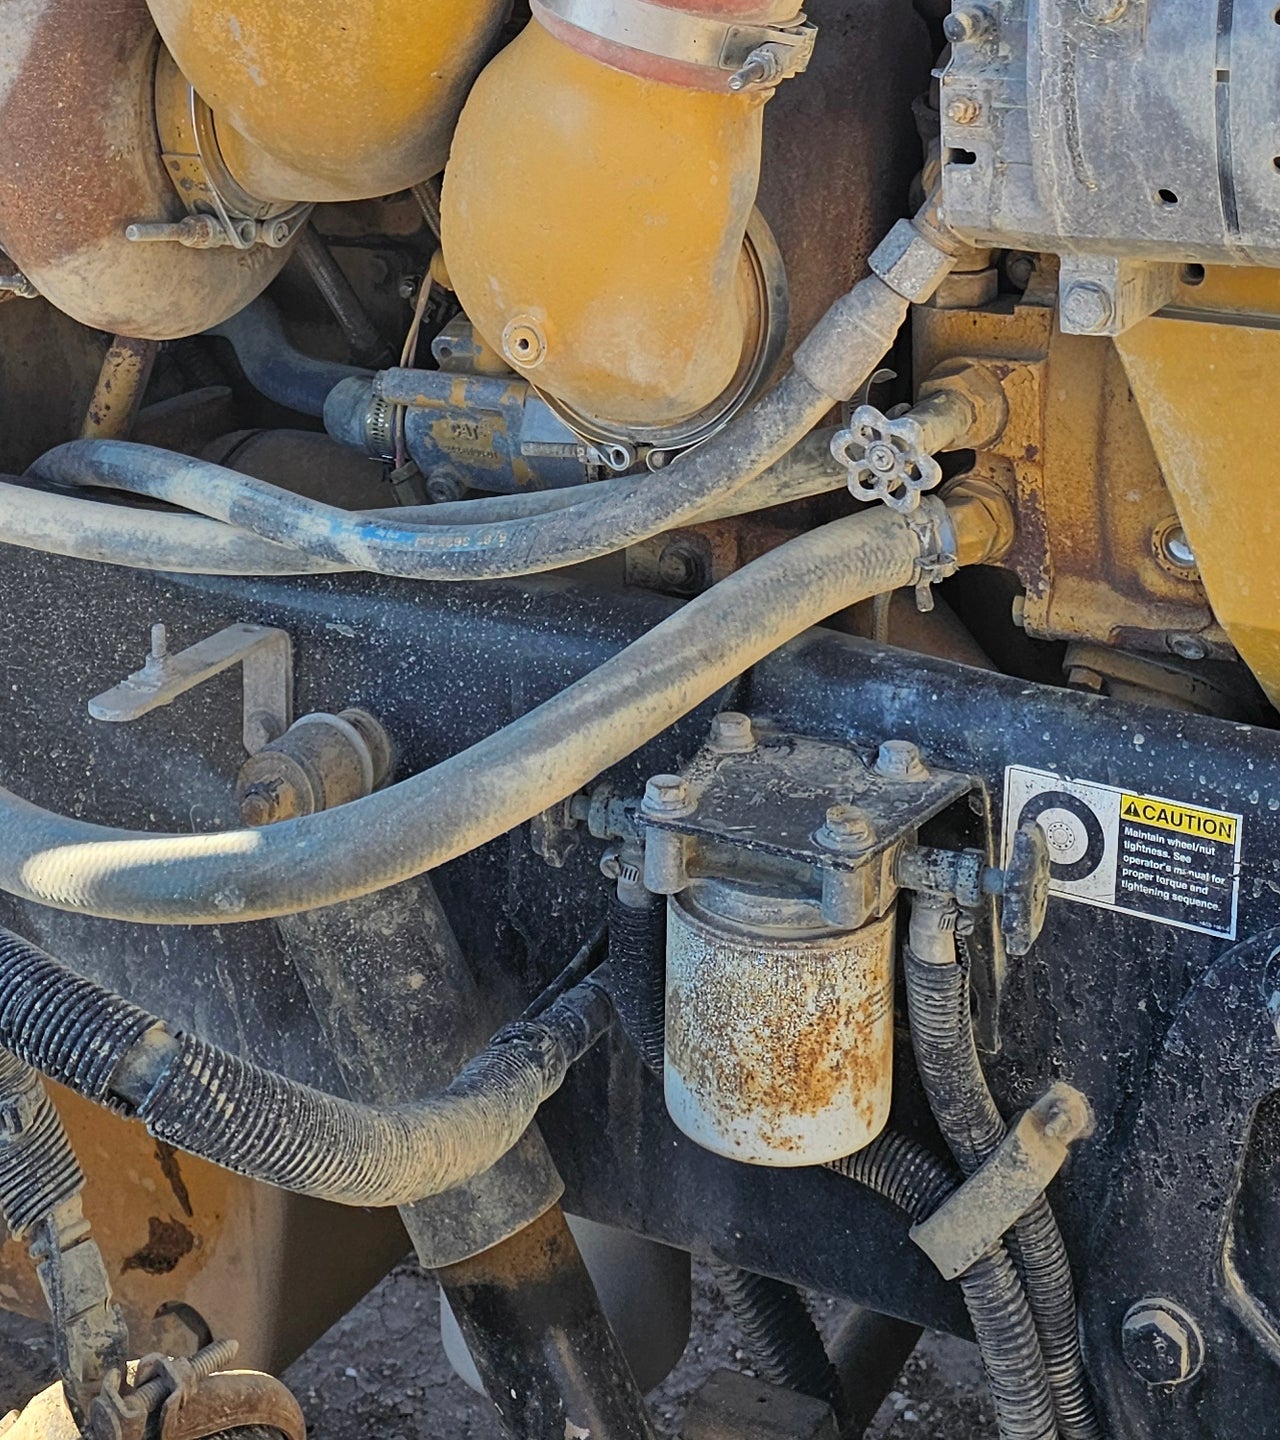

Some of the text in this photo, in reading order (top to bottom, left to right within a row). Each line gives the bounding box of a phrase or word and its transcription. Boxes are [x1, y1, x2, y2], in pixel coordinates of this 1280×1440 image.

[1142, 804, 1234, 840] CAUTION
[1123, 840, 1192, 864] tightness. See
[1124, 826, 1216, 857] Maintain wheel/nut
[1122, 855, 1172, 874] operator's
[1210, 872, 1226, 886] for
[1122, 867, 1209, 896] proper torque and
[1121, 880, 1222, 912] tightening sequence.
